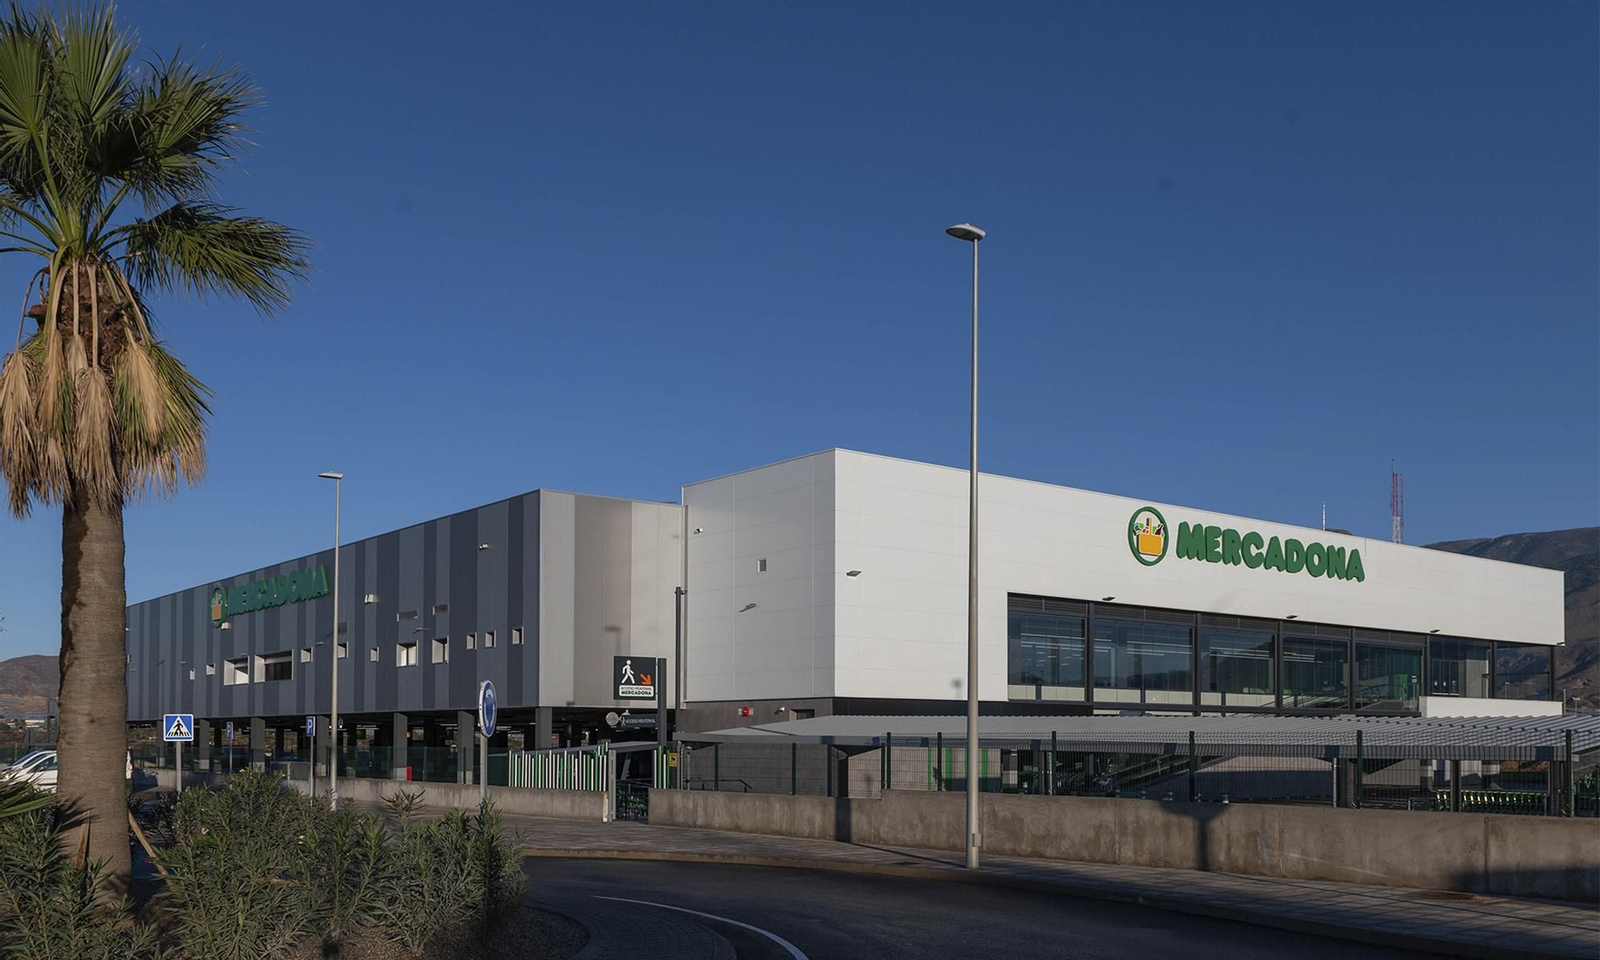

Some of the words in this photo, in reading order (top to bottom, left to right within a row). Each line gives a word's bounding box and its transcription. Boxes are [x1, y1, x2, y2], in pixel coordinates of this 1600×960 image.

[1175, 521, 1366, 583] MERCADONA
[226, 565, 329, 617] MERCADONA
[307, 719, 313, 734] P
